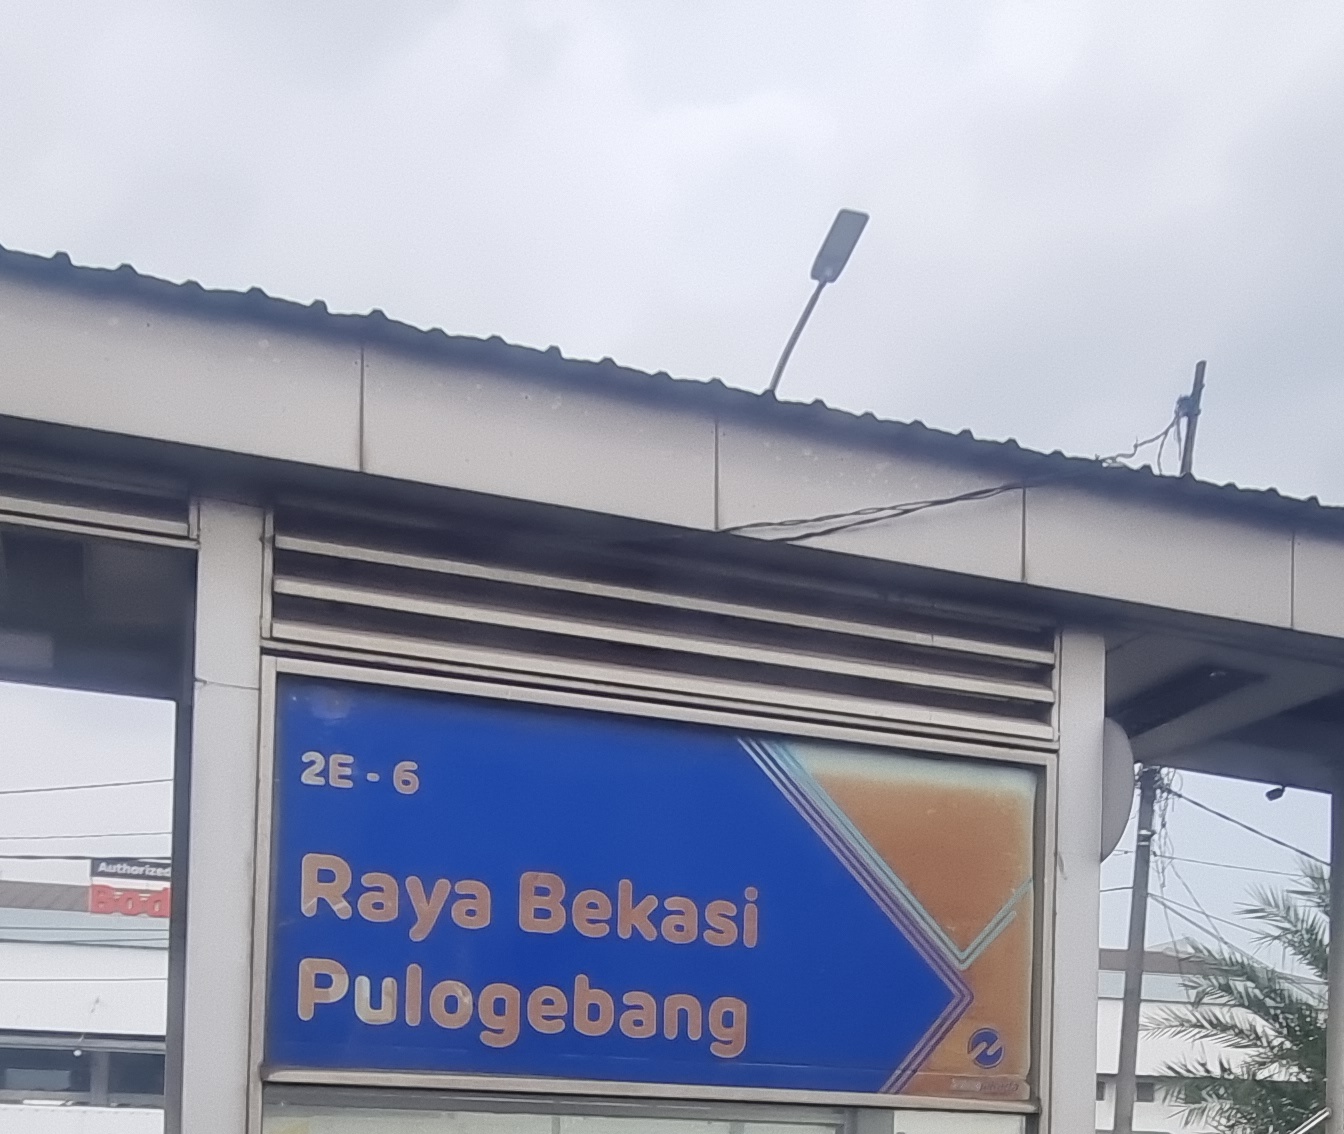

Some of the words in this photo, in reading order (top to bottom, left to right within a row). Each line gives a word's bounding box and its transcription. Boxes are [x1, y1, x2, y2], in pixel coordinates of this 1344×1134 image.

[300, 750, 355, 789] 2E
[393, 760, 420, 795] 6
[300, 852, 492, 942] Raya
[518, 870, 759, 948] Bekasi
[297, 956, 749, 1059] Pulogebang
